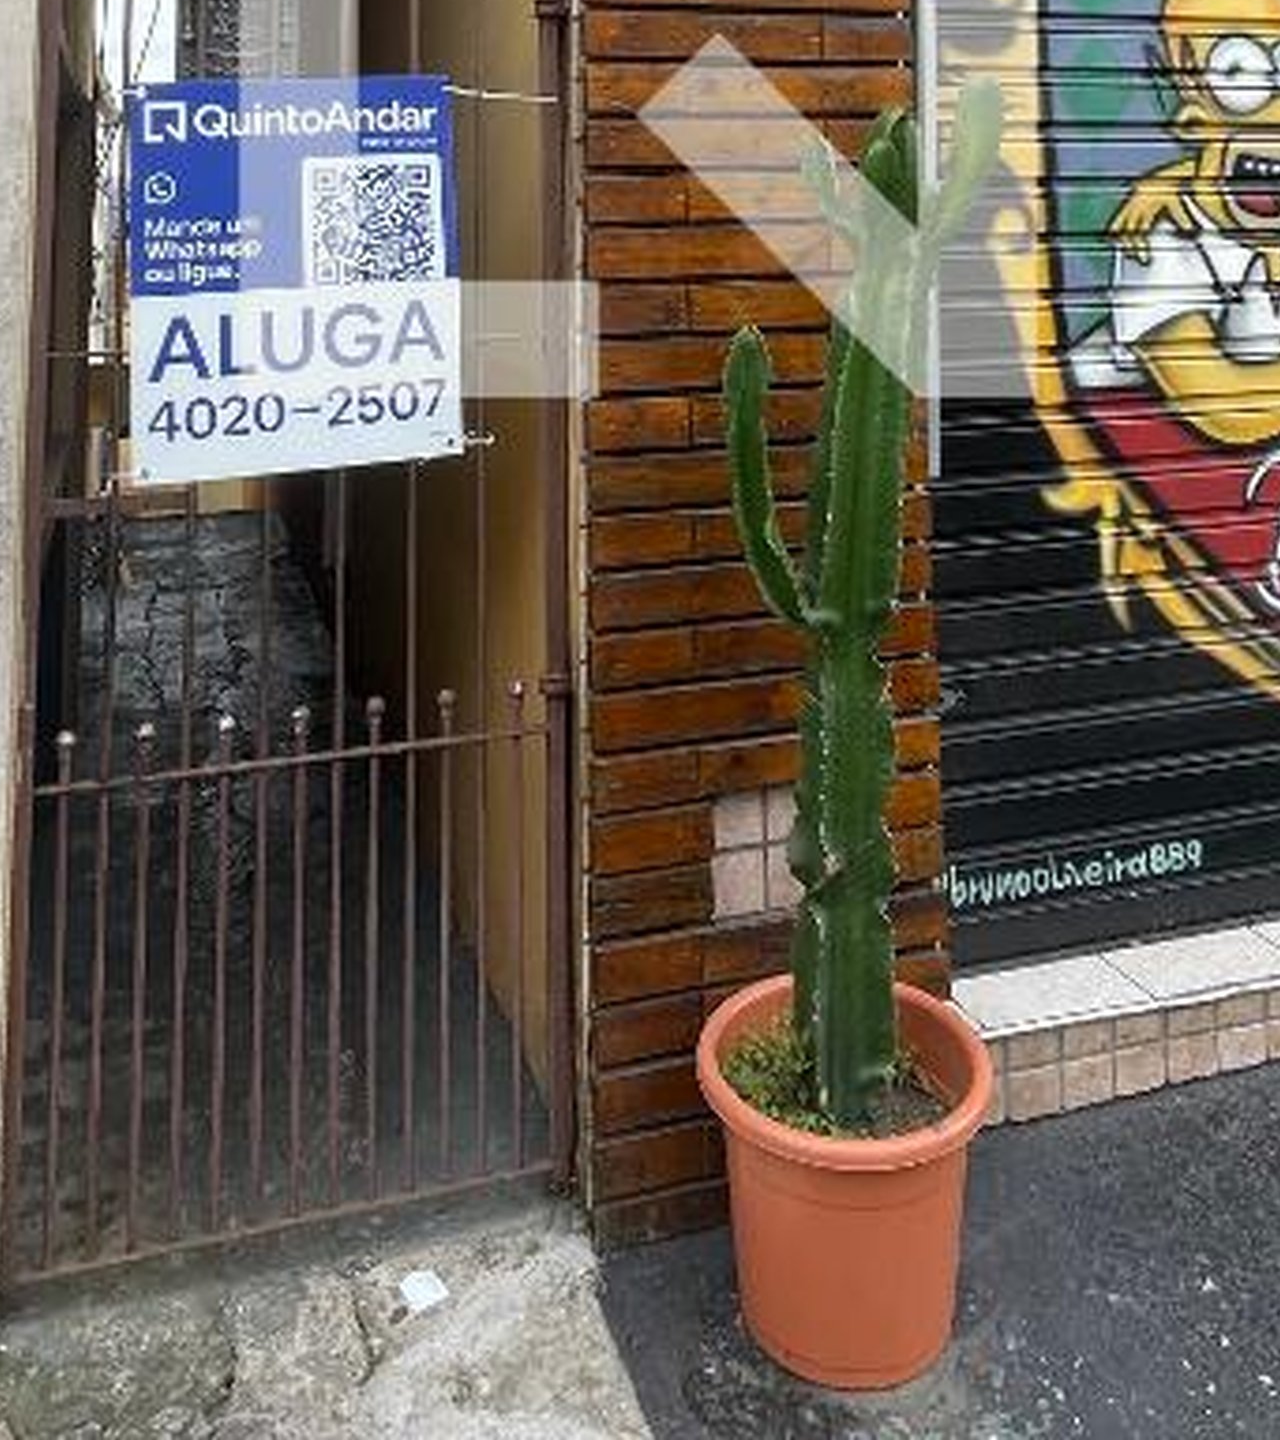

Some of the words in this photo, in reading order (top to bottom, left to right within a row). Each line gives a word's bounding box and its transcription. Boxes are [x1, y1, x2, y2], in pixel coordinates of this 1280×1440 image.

[194, 100, 438, 139] QuintoAndar
[147, 300, 447, 383] ALUGA
[147, 379, 447, 443] 4020-2507
